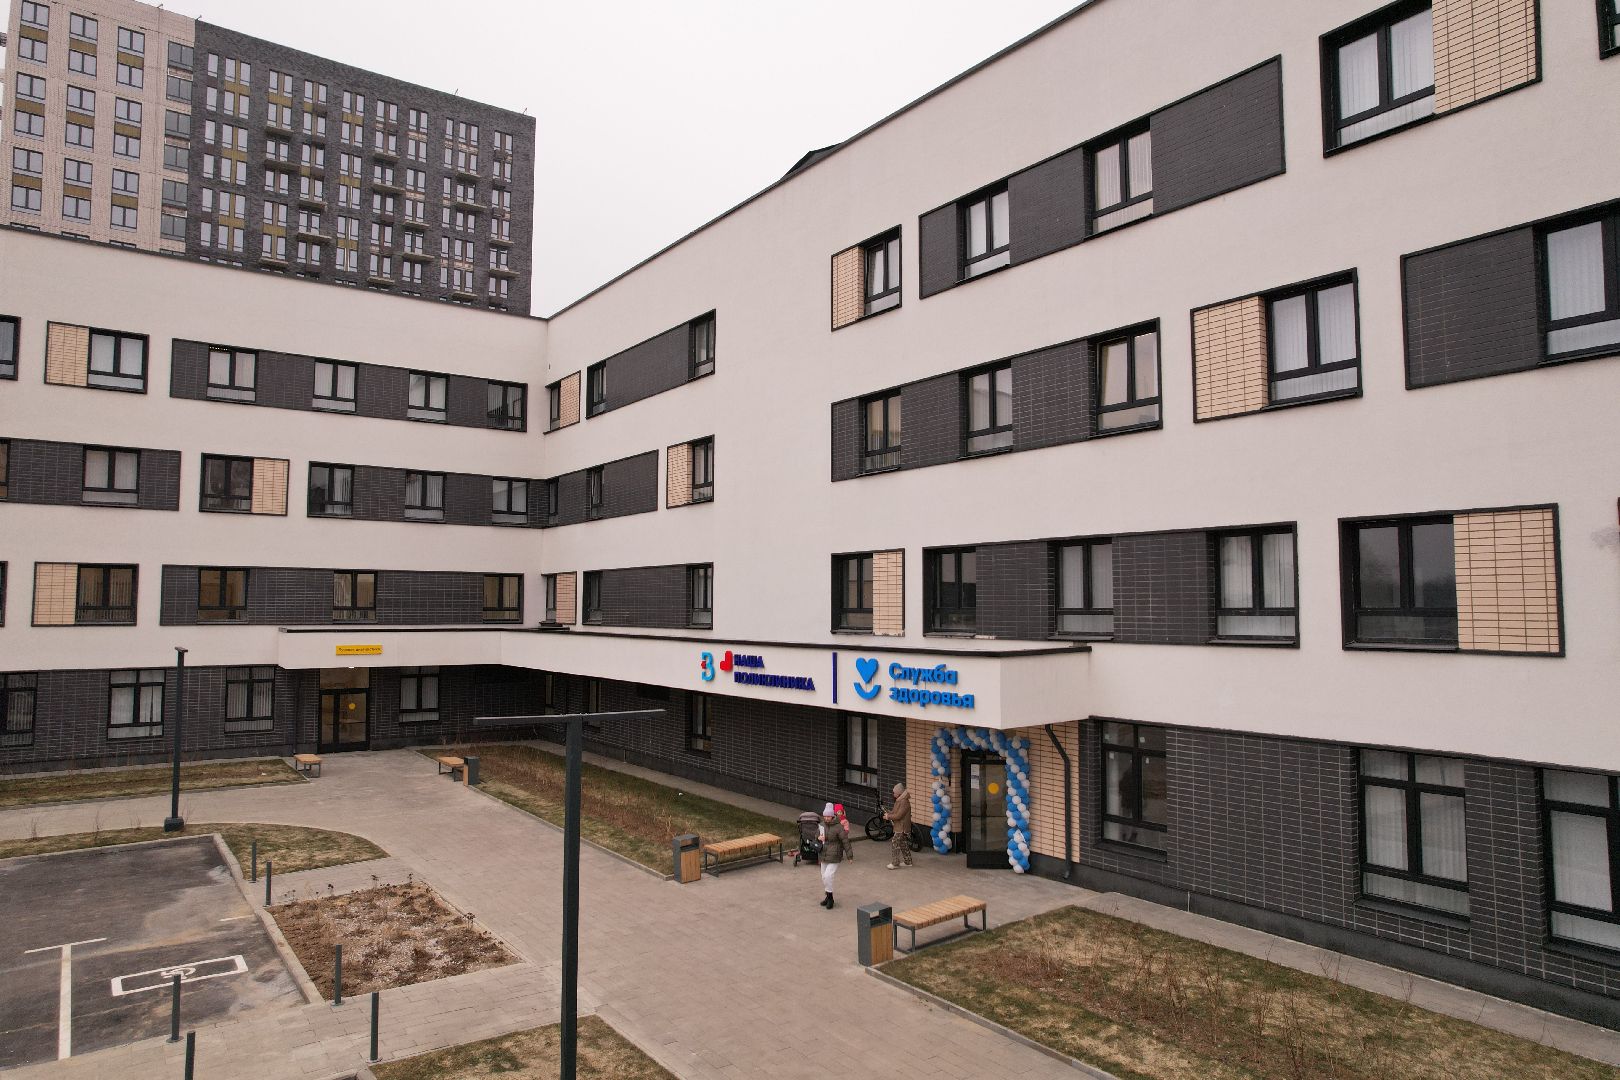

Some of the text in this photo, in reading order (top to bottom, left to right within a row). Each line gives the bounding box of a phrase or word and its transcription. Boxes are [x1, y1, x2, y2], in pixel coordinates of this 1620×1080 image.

[734, 654, 765, 668] НАША
[734, 671, 816, 691] ПОЛИКЛИНИКА
[888, 662, 958, 686] Служба
[888, 686, 975, 709] здоровья
